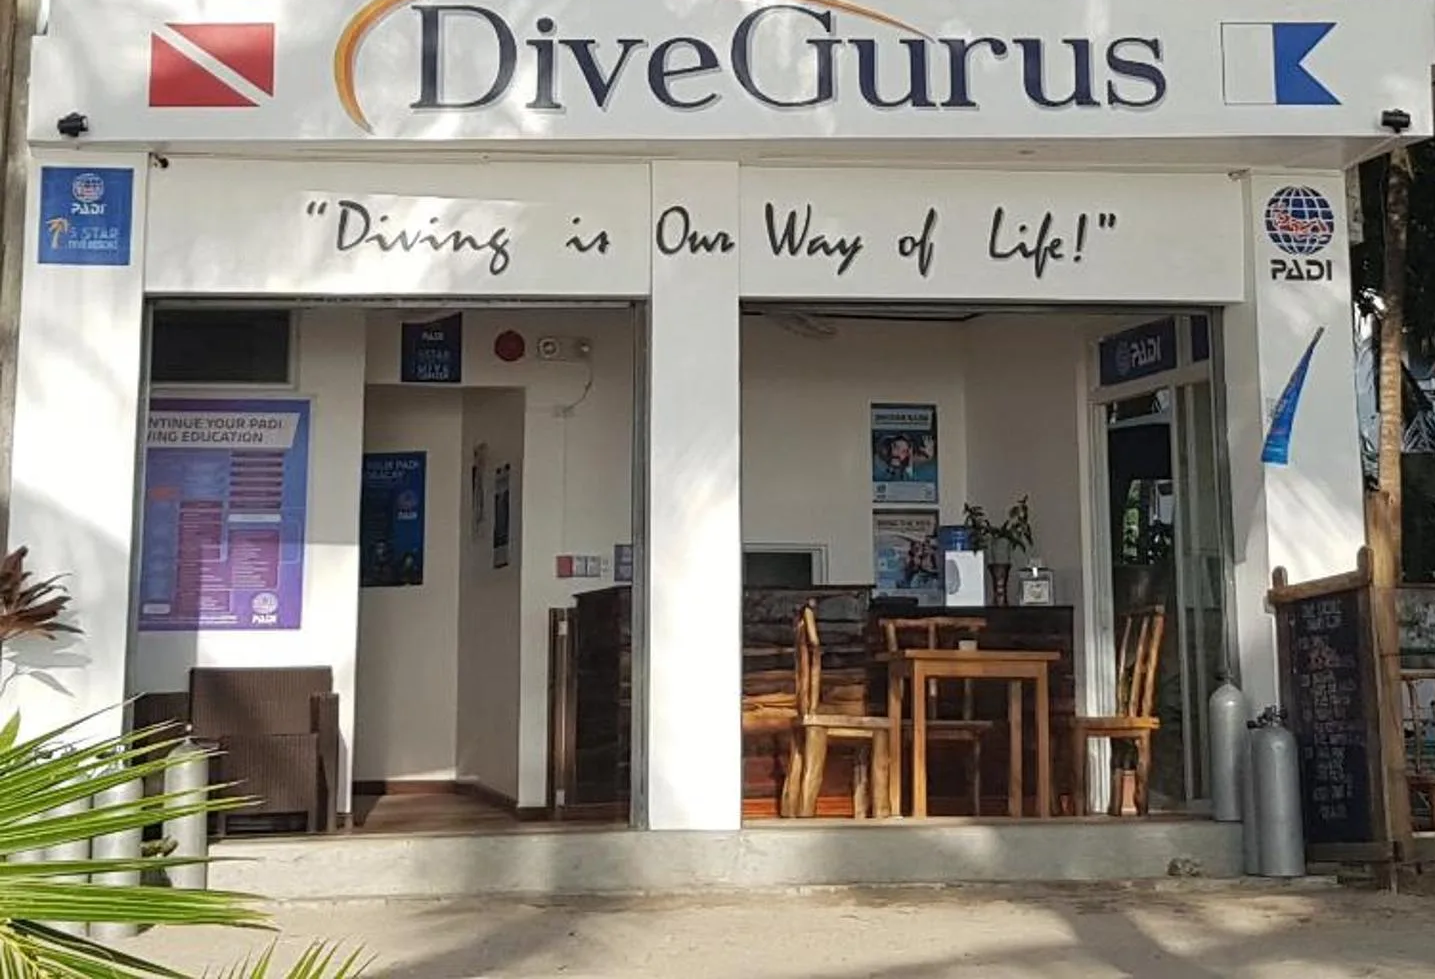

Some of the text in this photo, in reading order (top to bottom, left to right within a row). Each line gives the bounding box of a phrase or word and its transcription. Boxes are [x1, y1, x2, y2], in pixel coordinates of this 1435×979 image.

[410, 4, 1168, 113] DiveGurus
[71, 203, 107, 214] PADI
[82, 227, 118, 239] STAR
[565, 217, 610, 253] is
[656, 205, 735, 255] Our
[765, 202, 864, 275] Way
[899, 207, 937, 277] of
[1270, 259, 1333, 281] PADI
[1131, 335, 1162, 368] PADI
[206, 419, 246, 429] YOUR
[250, 420, 282, 429] PADI
[181, 431, 263, 442] EDUCATION
